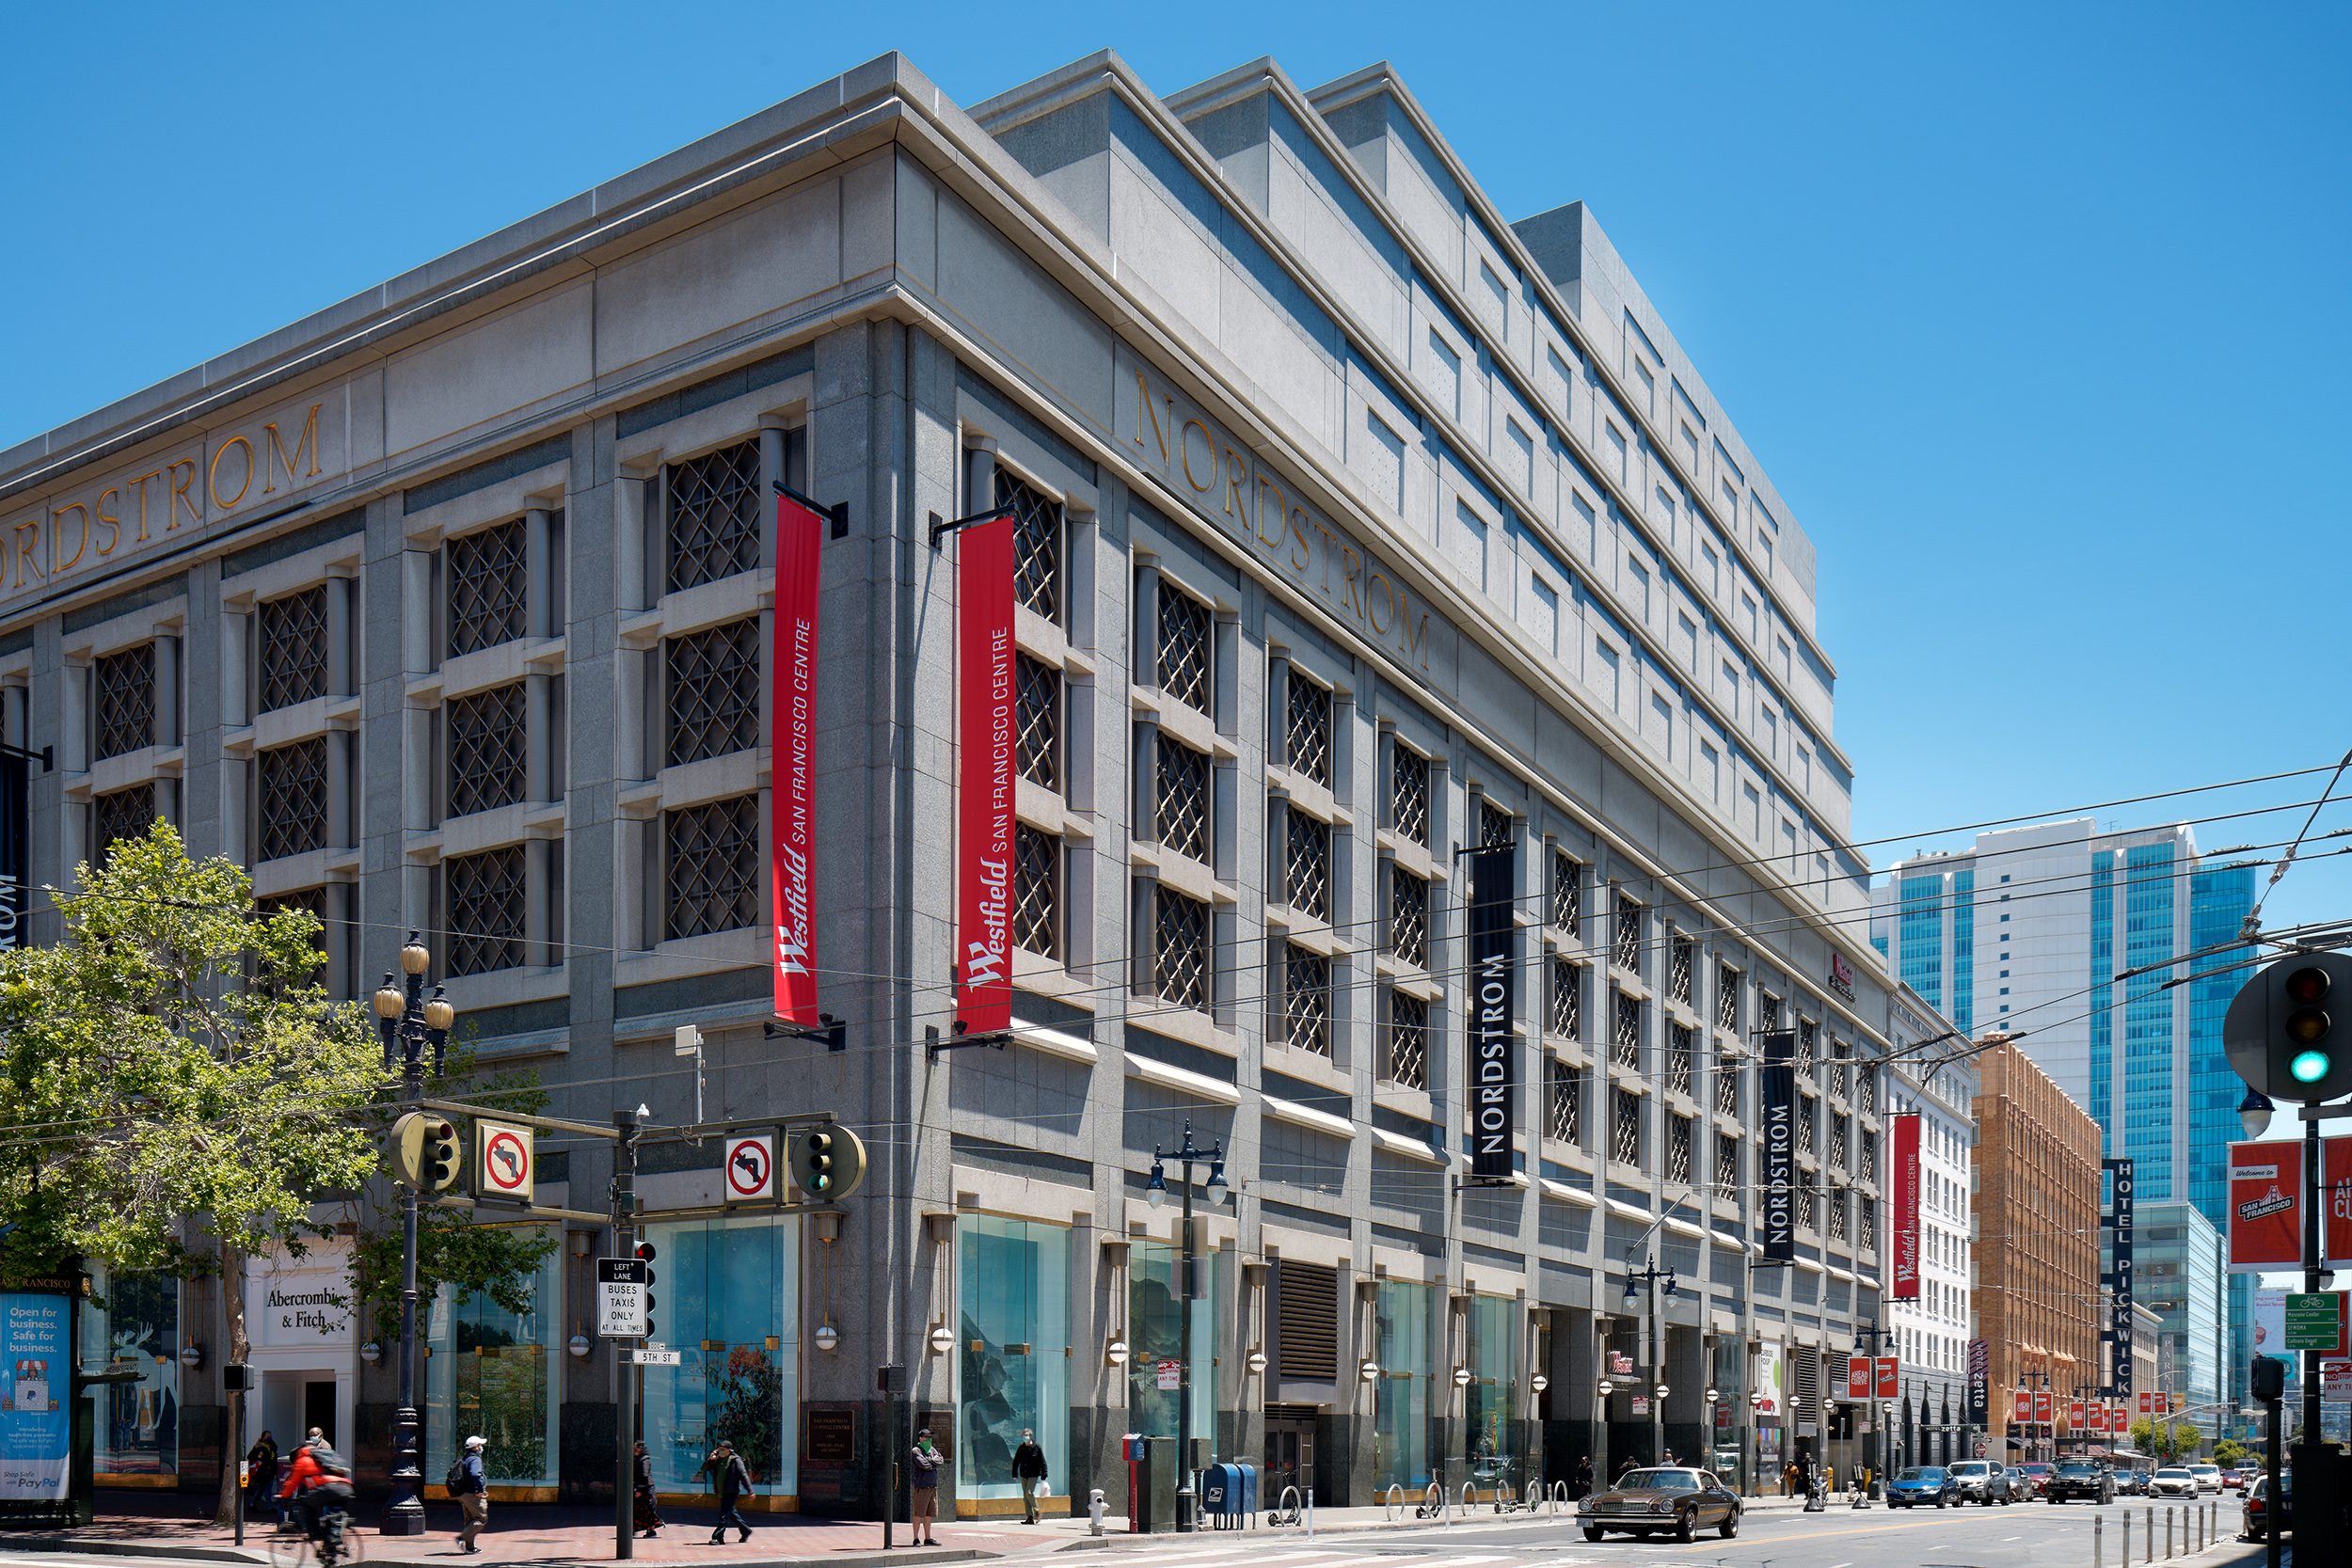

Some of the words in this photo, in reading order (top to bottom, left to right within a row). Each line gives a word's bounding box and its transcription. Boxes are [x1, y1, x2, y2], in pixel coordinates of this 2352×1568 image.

[1135, 369, 1429, 671] NORDSTROM
[793, 617, 811, 691] CENTRE
[992, 626, 1008, 700] CENTRE
[791, 699, 808, 801] FRANCISCO
[993, 705, 1009, 809] FRANCISCO
[790, 805, 806, 845] SAN
[992, 813, 1008, 853] SAN
[779, 843, 810, 978] Westfield
[967, 857, 1007, 993] Westfield
[1482, 953, 1505, 1154] NORDSTROM
[1770, 1104, 1788, 1243] NORDSTROM
[1907, 1152, 1916, 1180] CENTRE
[1907, 1180, 1916, 1219] FRANCISCO
[2117, 1163, 2132, 1243] HOTEL
[2241, 1202, 2258, 1213] SAN
[2246, 1198, 2291, 1219] FRANCISCO
[1907, 1219, 1915, 1234] SAN
[1897, 1231, 1915, 1284] Westfield
[266, 1287, 337, 1307] Abercrombi
[608, 1285, 637, 1295] BUSES
[610, 1298, 636, 1307] TAXIS
[9, 1307, 39, 1319] Open
[42, 1307, 57, 1317] for
[9, 1319, 57, 1329] business.
[282, 1315, 293, 1328] &
[295, 1309, 326, 1327] Fitch
[611, 1311, 634, 1321] ONLY
[2116, 1259, 2132, 1395] PICKWICK
[9, 1342, 57, 1353] business.
[12, 1330, 36, 1340] Safe
[39, 1330, 55, 1340] for
[643, 1353, 658, 1362] 5TH
[662, 1354, 672, 1362] ST
[1975, 1343, 1983, 1371] HOTEL
[1851, 1370, 1868, 1379] AHEAD
[1851, 1376, 1868, 1386] CURVE
[1973, 1372, 1985, 1408] zetta
[18, 1478, 60, 1489] PayPal
